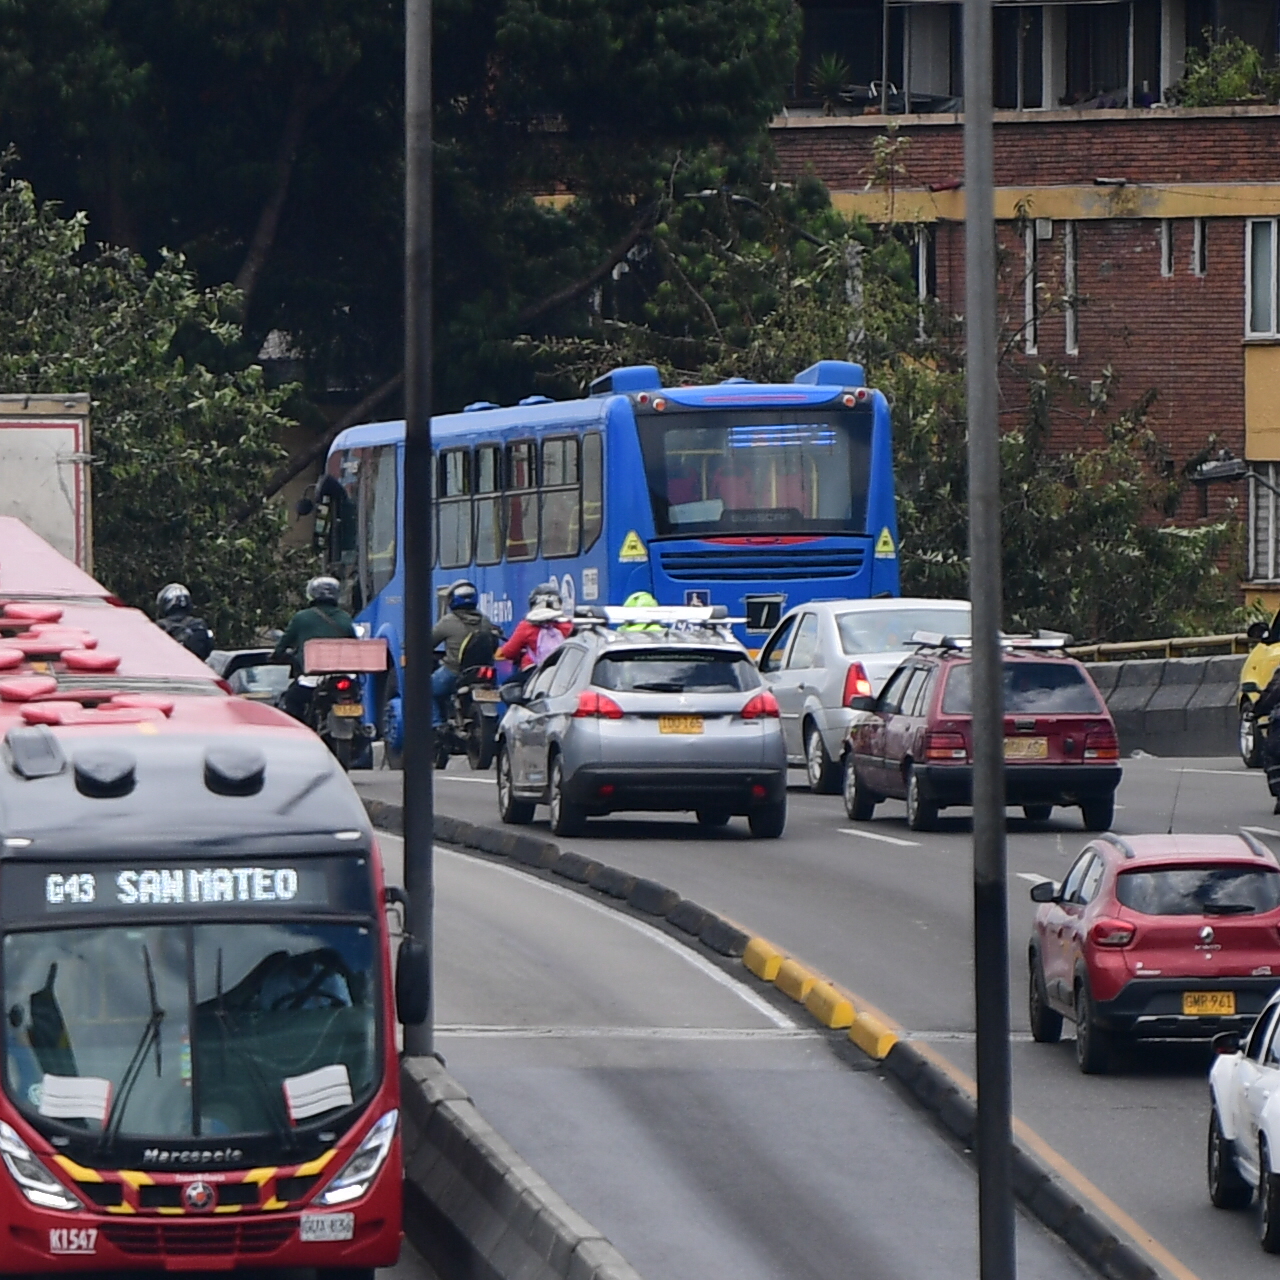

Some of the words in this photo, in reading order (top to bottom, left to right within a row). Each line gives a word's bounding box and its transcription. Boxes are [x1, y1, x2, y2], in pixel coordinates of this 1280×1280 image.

[46, 873, 96, 904] G43
[116, 869, 184, 904] SAN
[189, 867, 298, 902] MATEO
[49, 1228, 98, 1249] K1547
